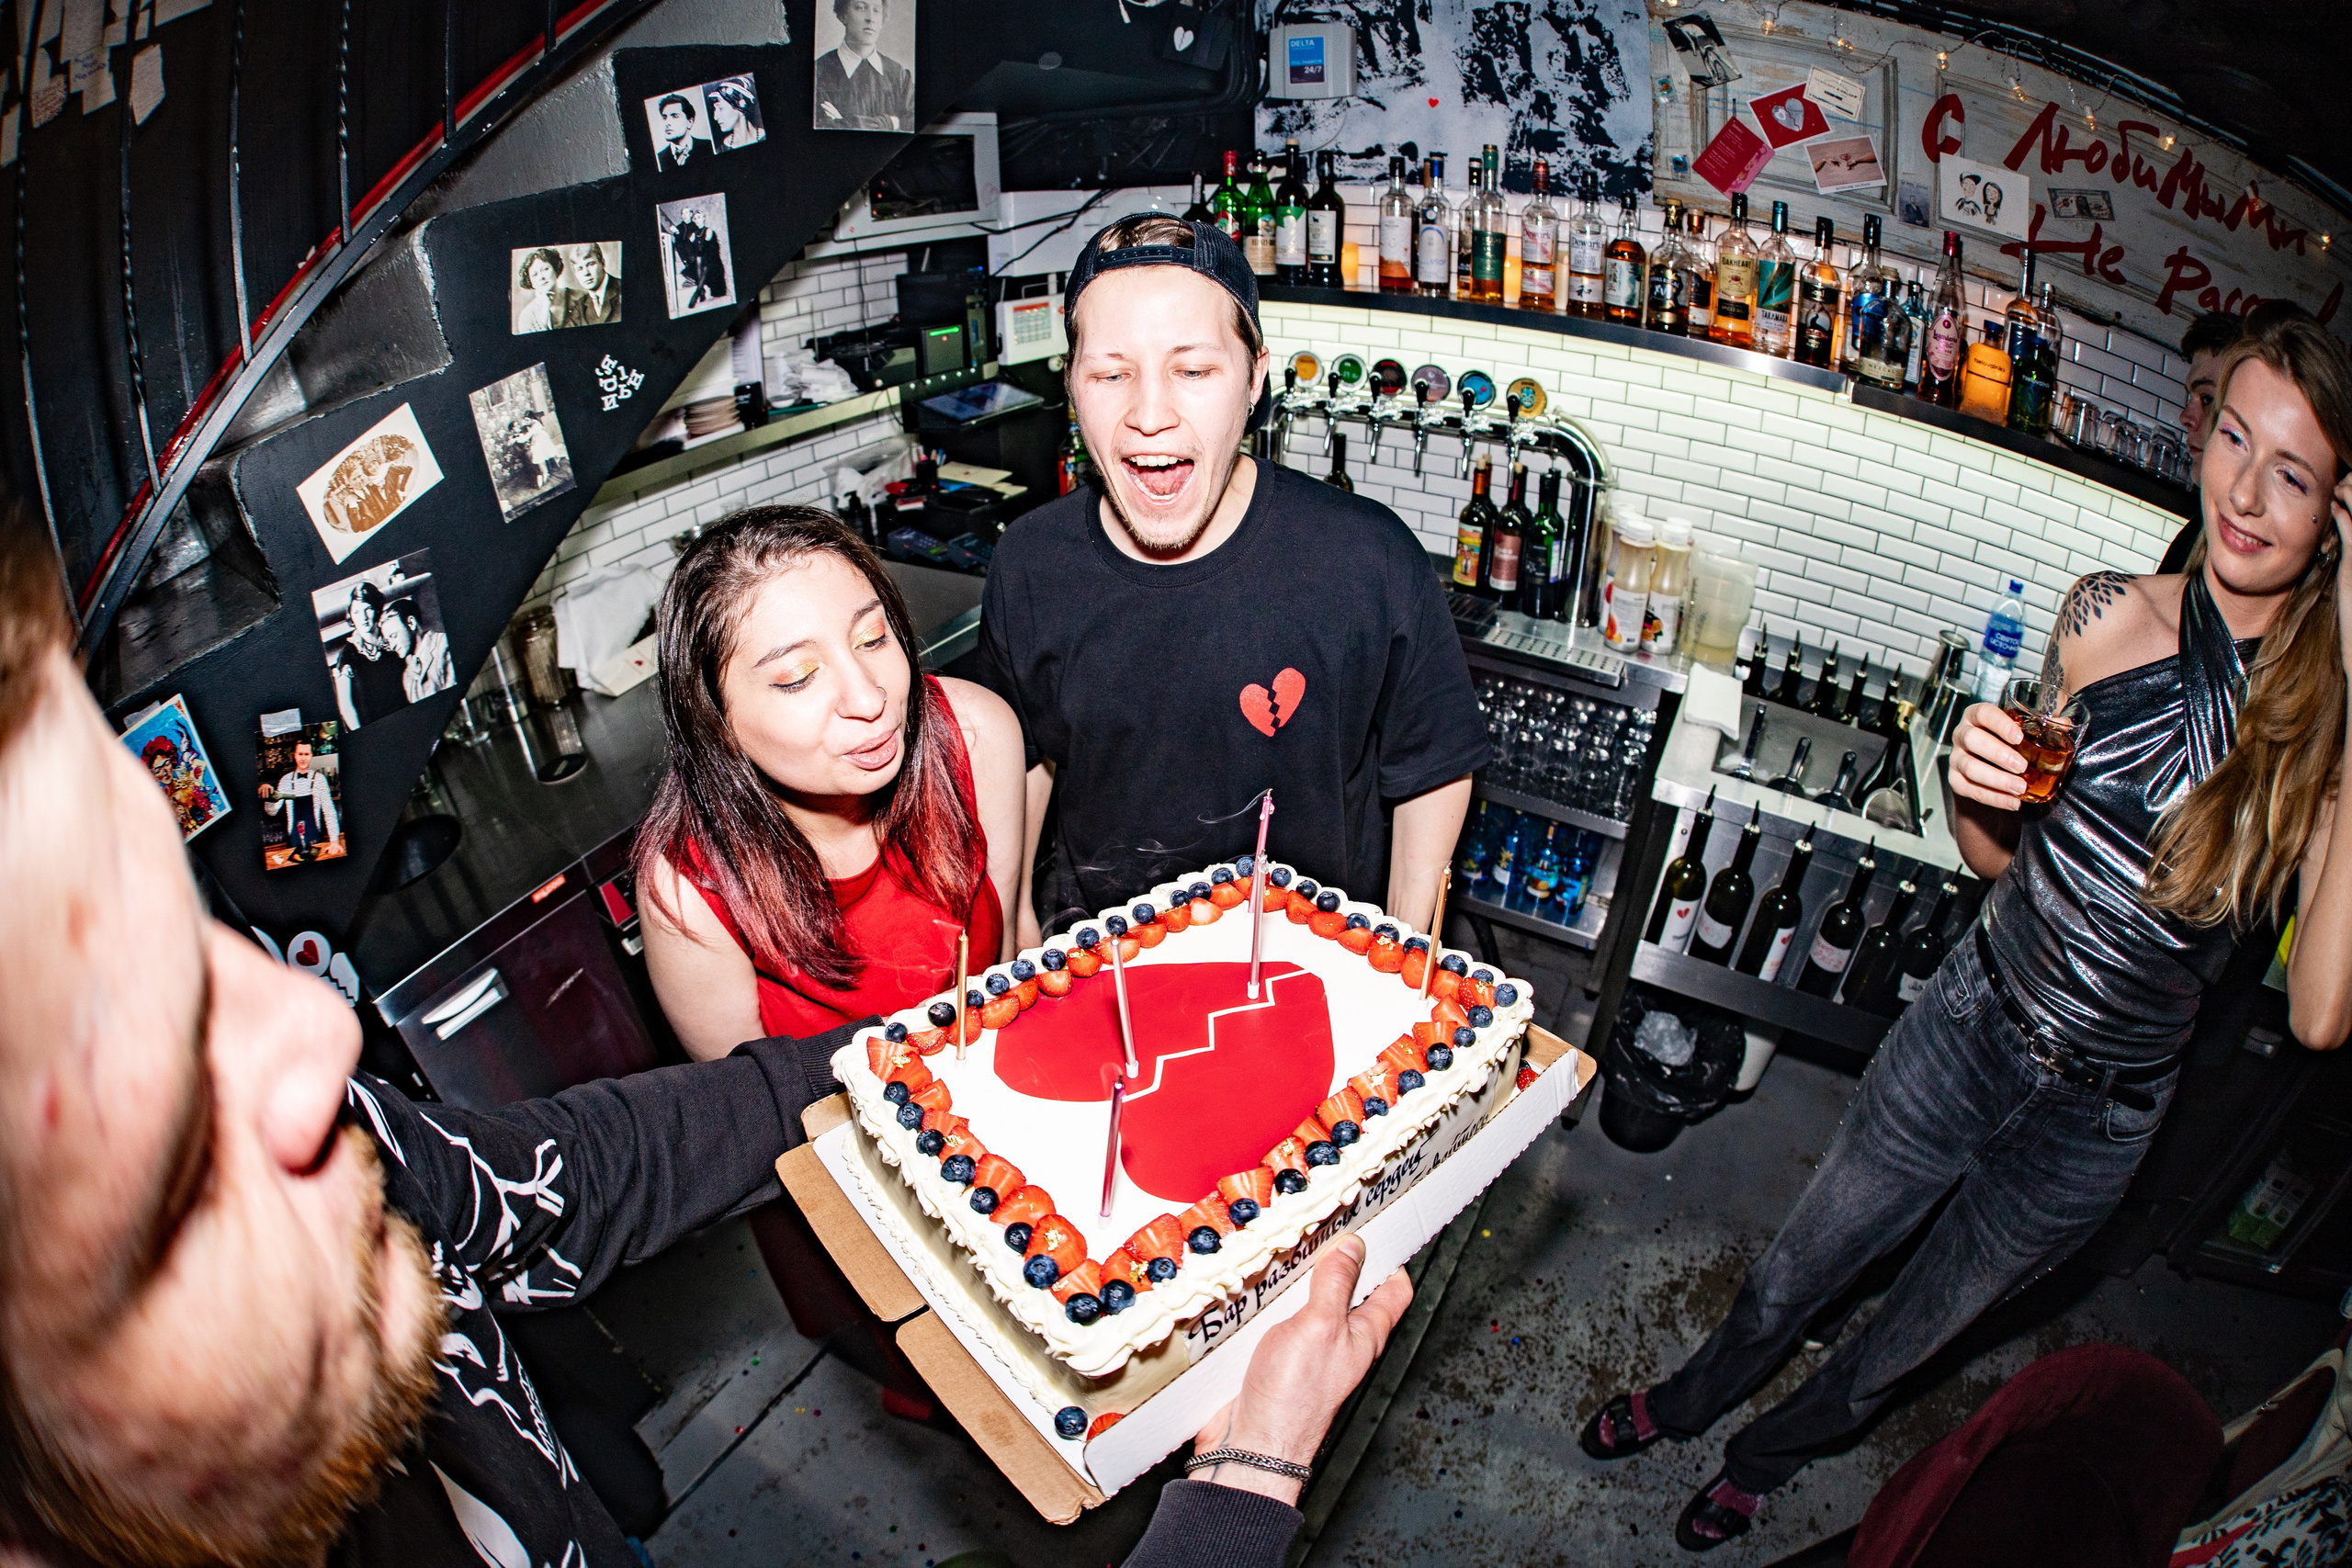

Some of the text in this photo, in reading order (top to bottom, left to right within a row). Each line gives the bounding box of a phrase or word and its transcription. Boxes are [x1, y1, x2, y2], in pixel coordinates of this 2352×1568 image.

[1290, 39, 1315, 48] DELTA
[1304, 65, 1322, 74] 24/7
[1921, 93, 1965, 163] С
[1572, 236, 1600, 248] Dewar's
[2000, 203, 2127, 285] Не
[1722, 256, 1751, 270] OAKHEART
[1996, 632, 2019, 646] СВЯТО
[1188, 1132, 1437, 1343] Бар разбитых сердец
